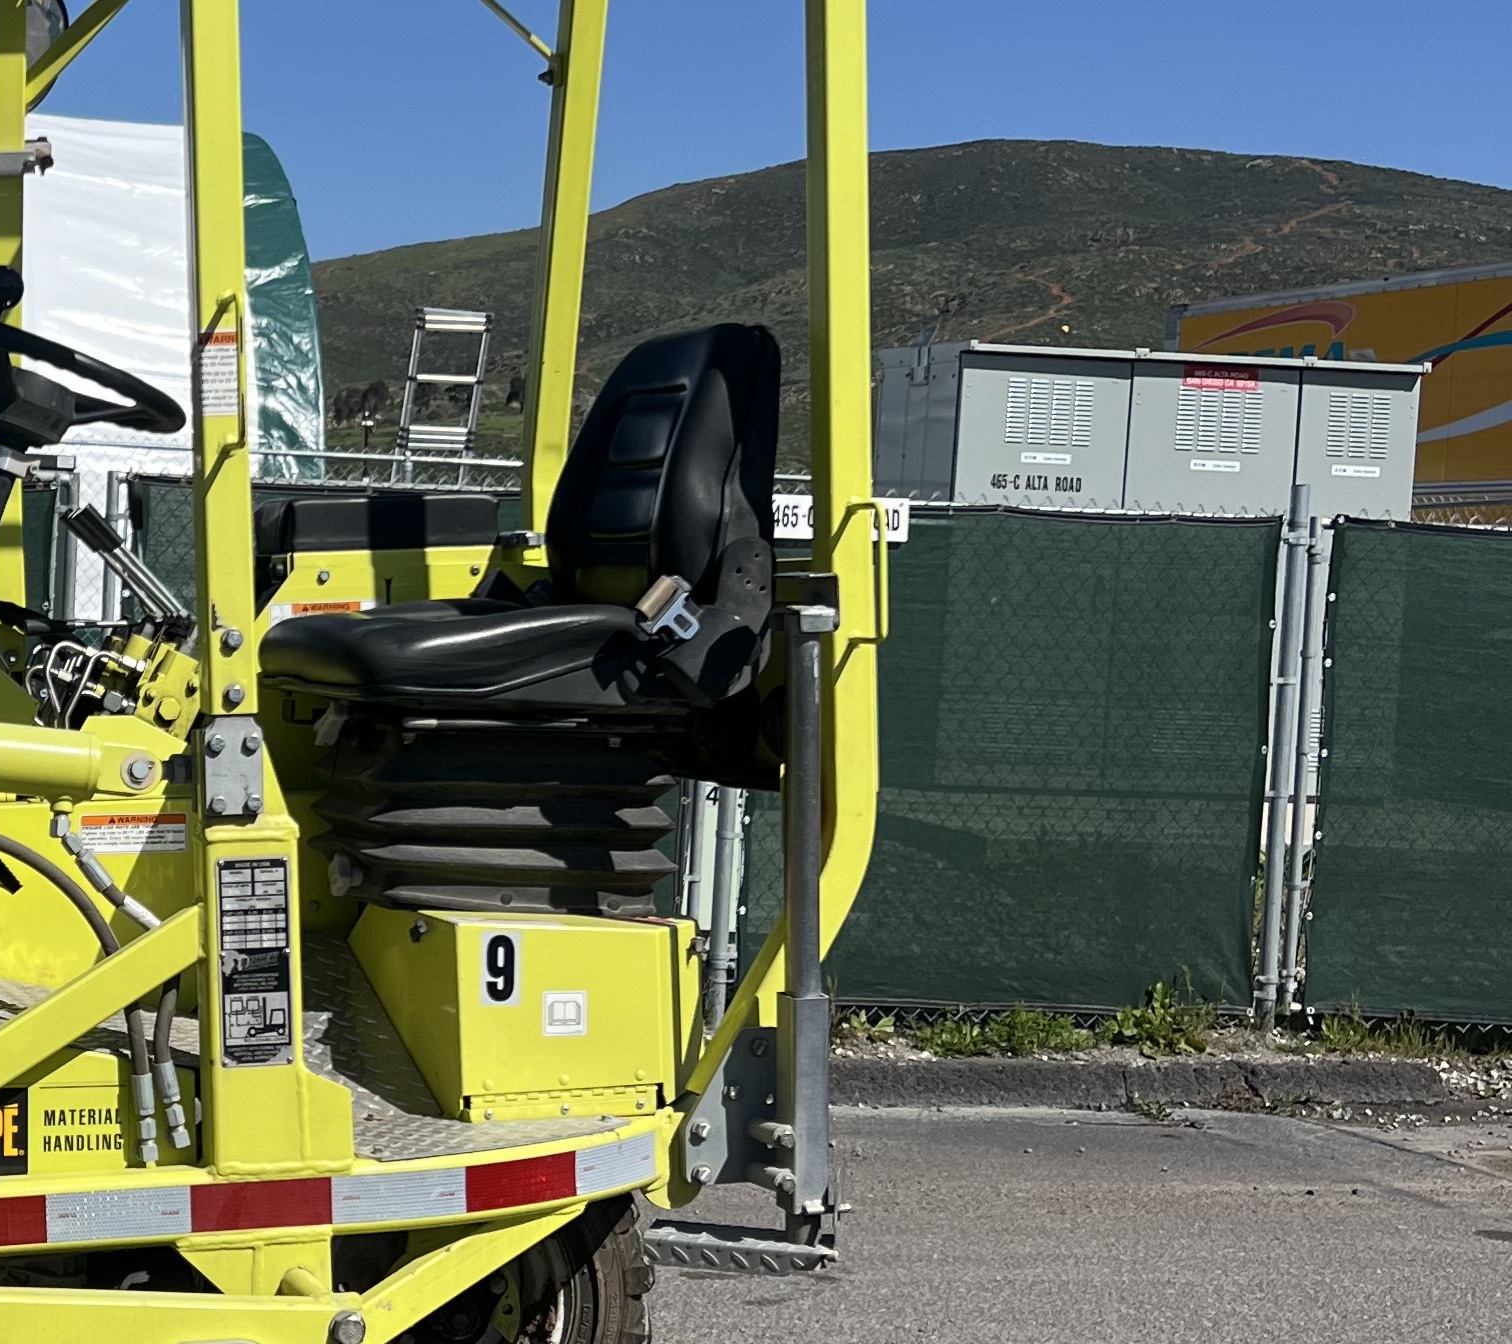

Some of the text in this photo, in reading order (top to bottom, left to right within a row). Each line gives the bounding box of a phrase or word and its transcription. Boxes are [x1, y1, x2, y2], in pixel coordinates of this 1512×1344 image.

[990, 474, 1082, 492] 465-C ALTA ROAD
[310, 603, 350, 612] WARNING
[486, 934, 515, 1002] 9
[44, 1108, 122, 1126] MATERIAL
[43, 1134, 122, 1152] HANDLING
